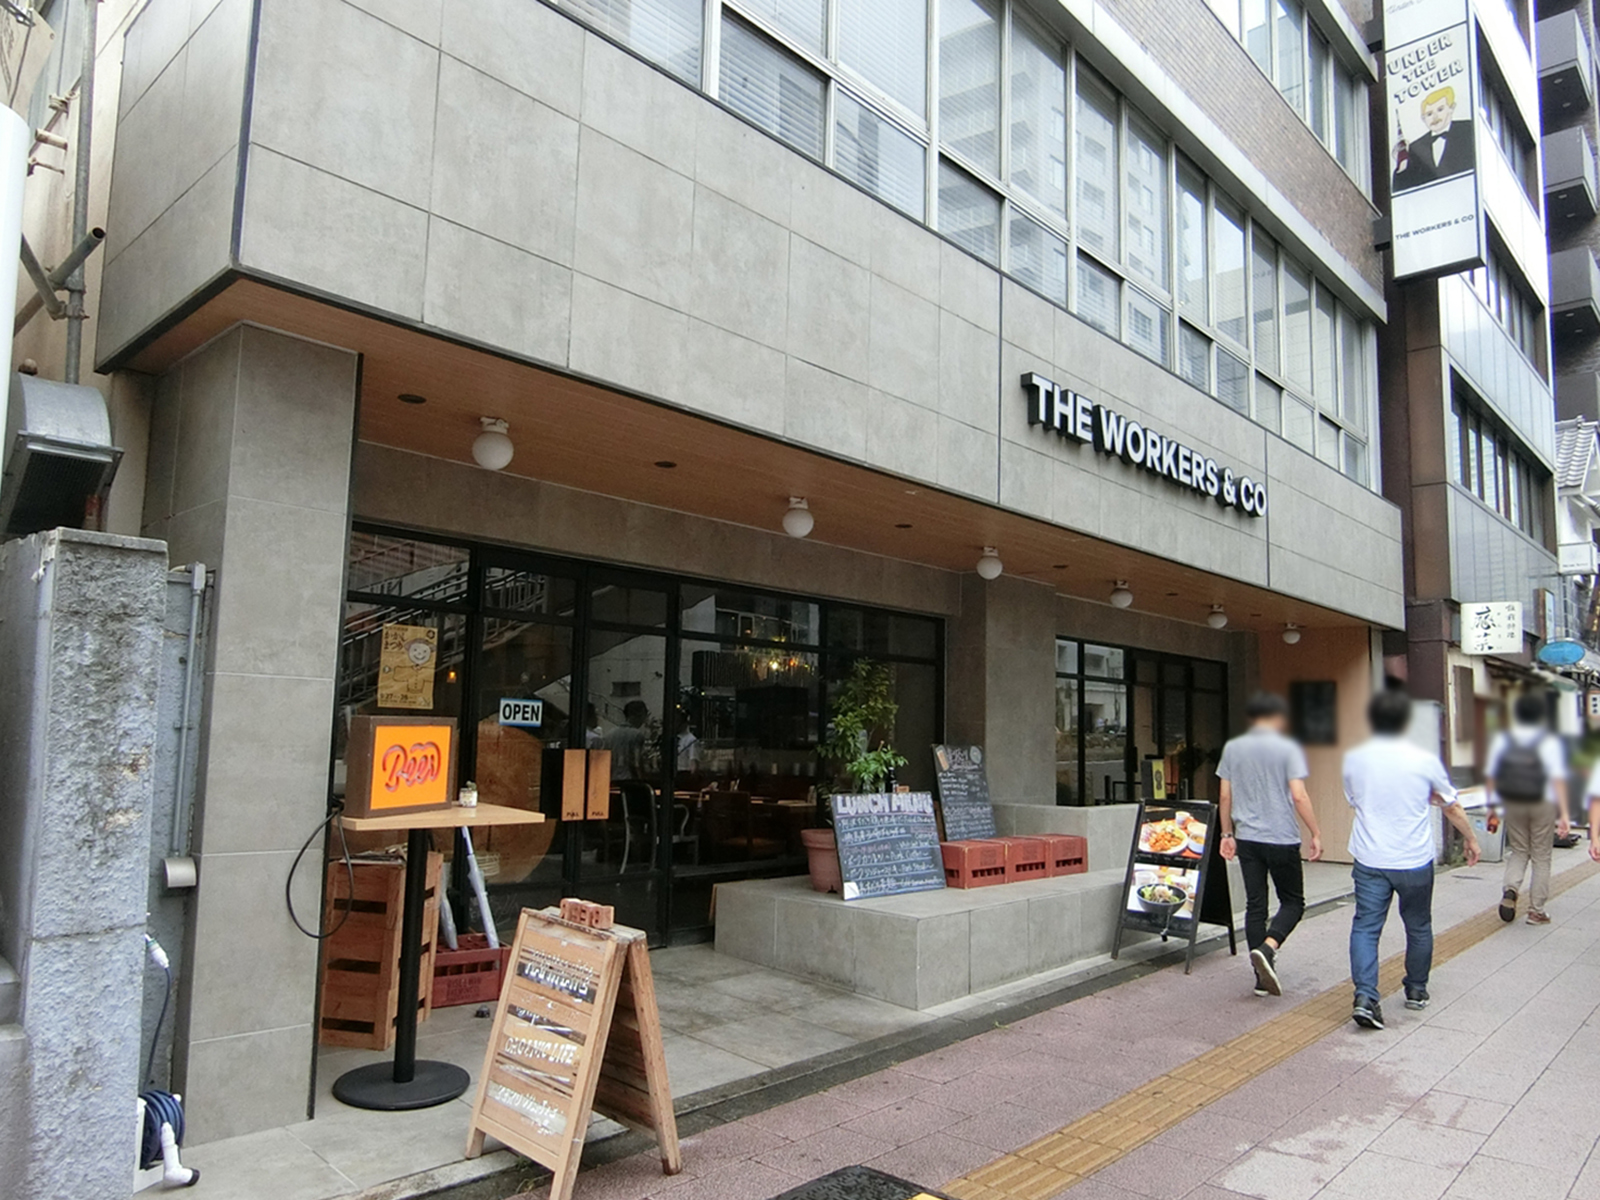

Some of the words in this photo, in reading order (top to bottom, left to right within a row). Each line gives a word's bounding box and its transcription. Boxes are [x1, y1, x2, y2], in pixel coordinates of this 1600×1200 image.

[1387, 34, 1453, 75] UNDER
[1394, 60, 1464, 104] TOWER
[1402, 59, 1437, 83] THE
[1412, 220, 1452, 235] WORKERS
[1461, 214, 1474, 222] CO
[1029, 373, 1093, 443] THE
[1098, 405, 1219, 496] WORKERS
[1222, 467, 1237, 505] &
[1240, 476, 1267, 517] CO
[502, 703, 540, 721] OPEN
[836, 794, 891, 815] LUNCH
[548, 1042, 578, 1064] LIFE
